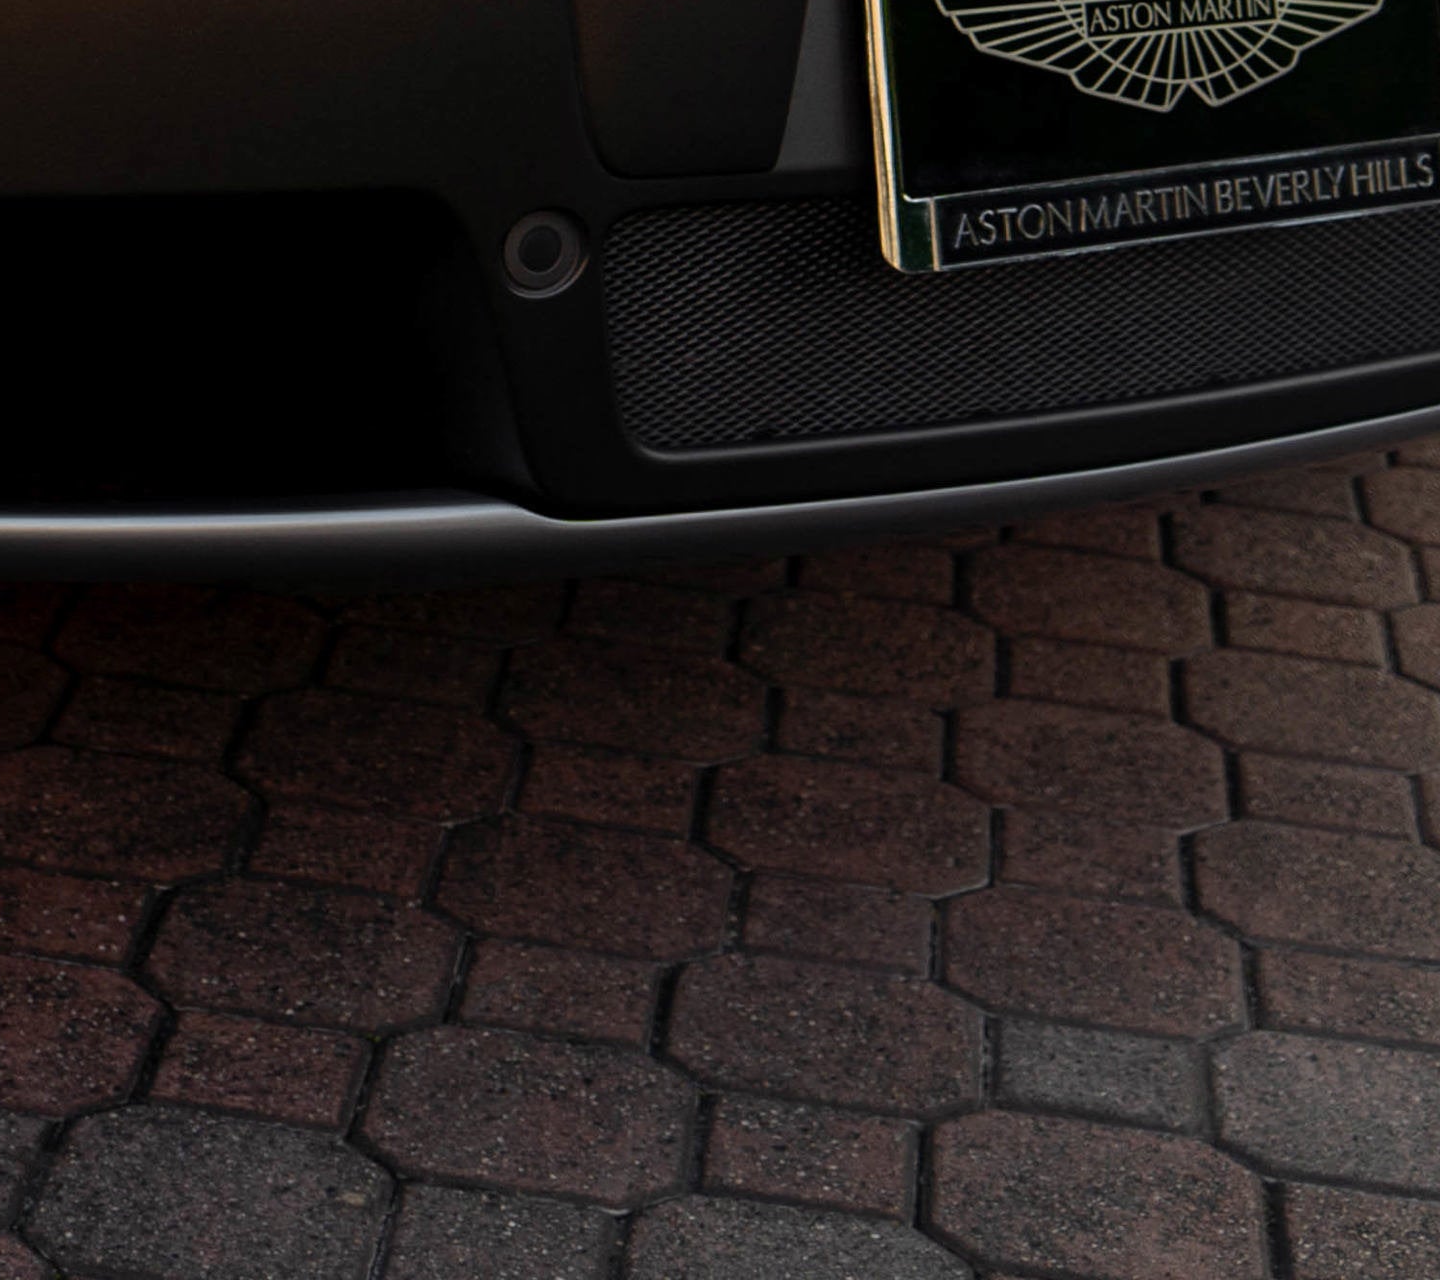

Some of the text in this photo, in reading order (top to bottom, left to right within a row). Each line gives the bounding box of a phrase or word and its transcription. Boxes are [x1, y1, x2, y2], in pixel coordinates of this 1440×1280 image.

[1089, 0, 1172, 35] ASTON
[954, 152, 1434, 248] ASTON MARTIN BEVERLY HILLS
